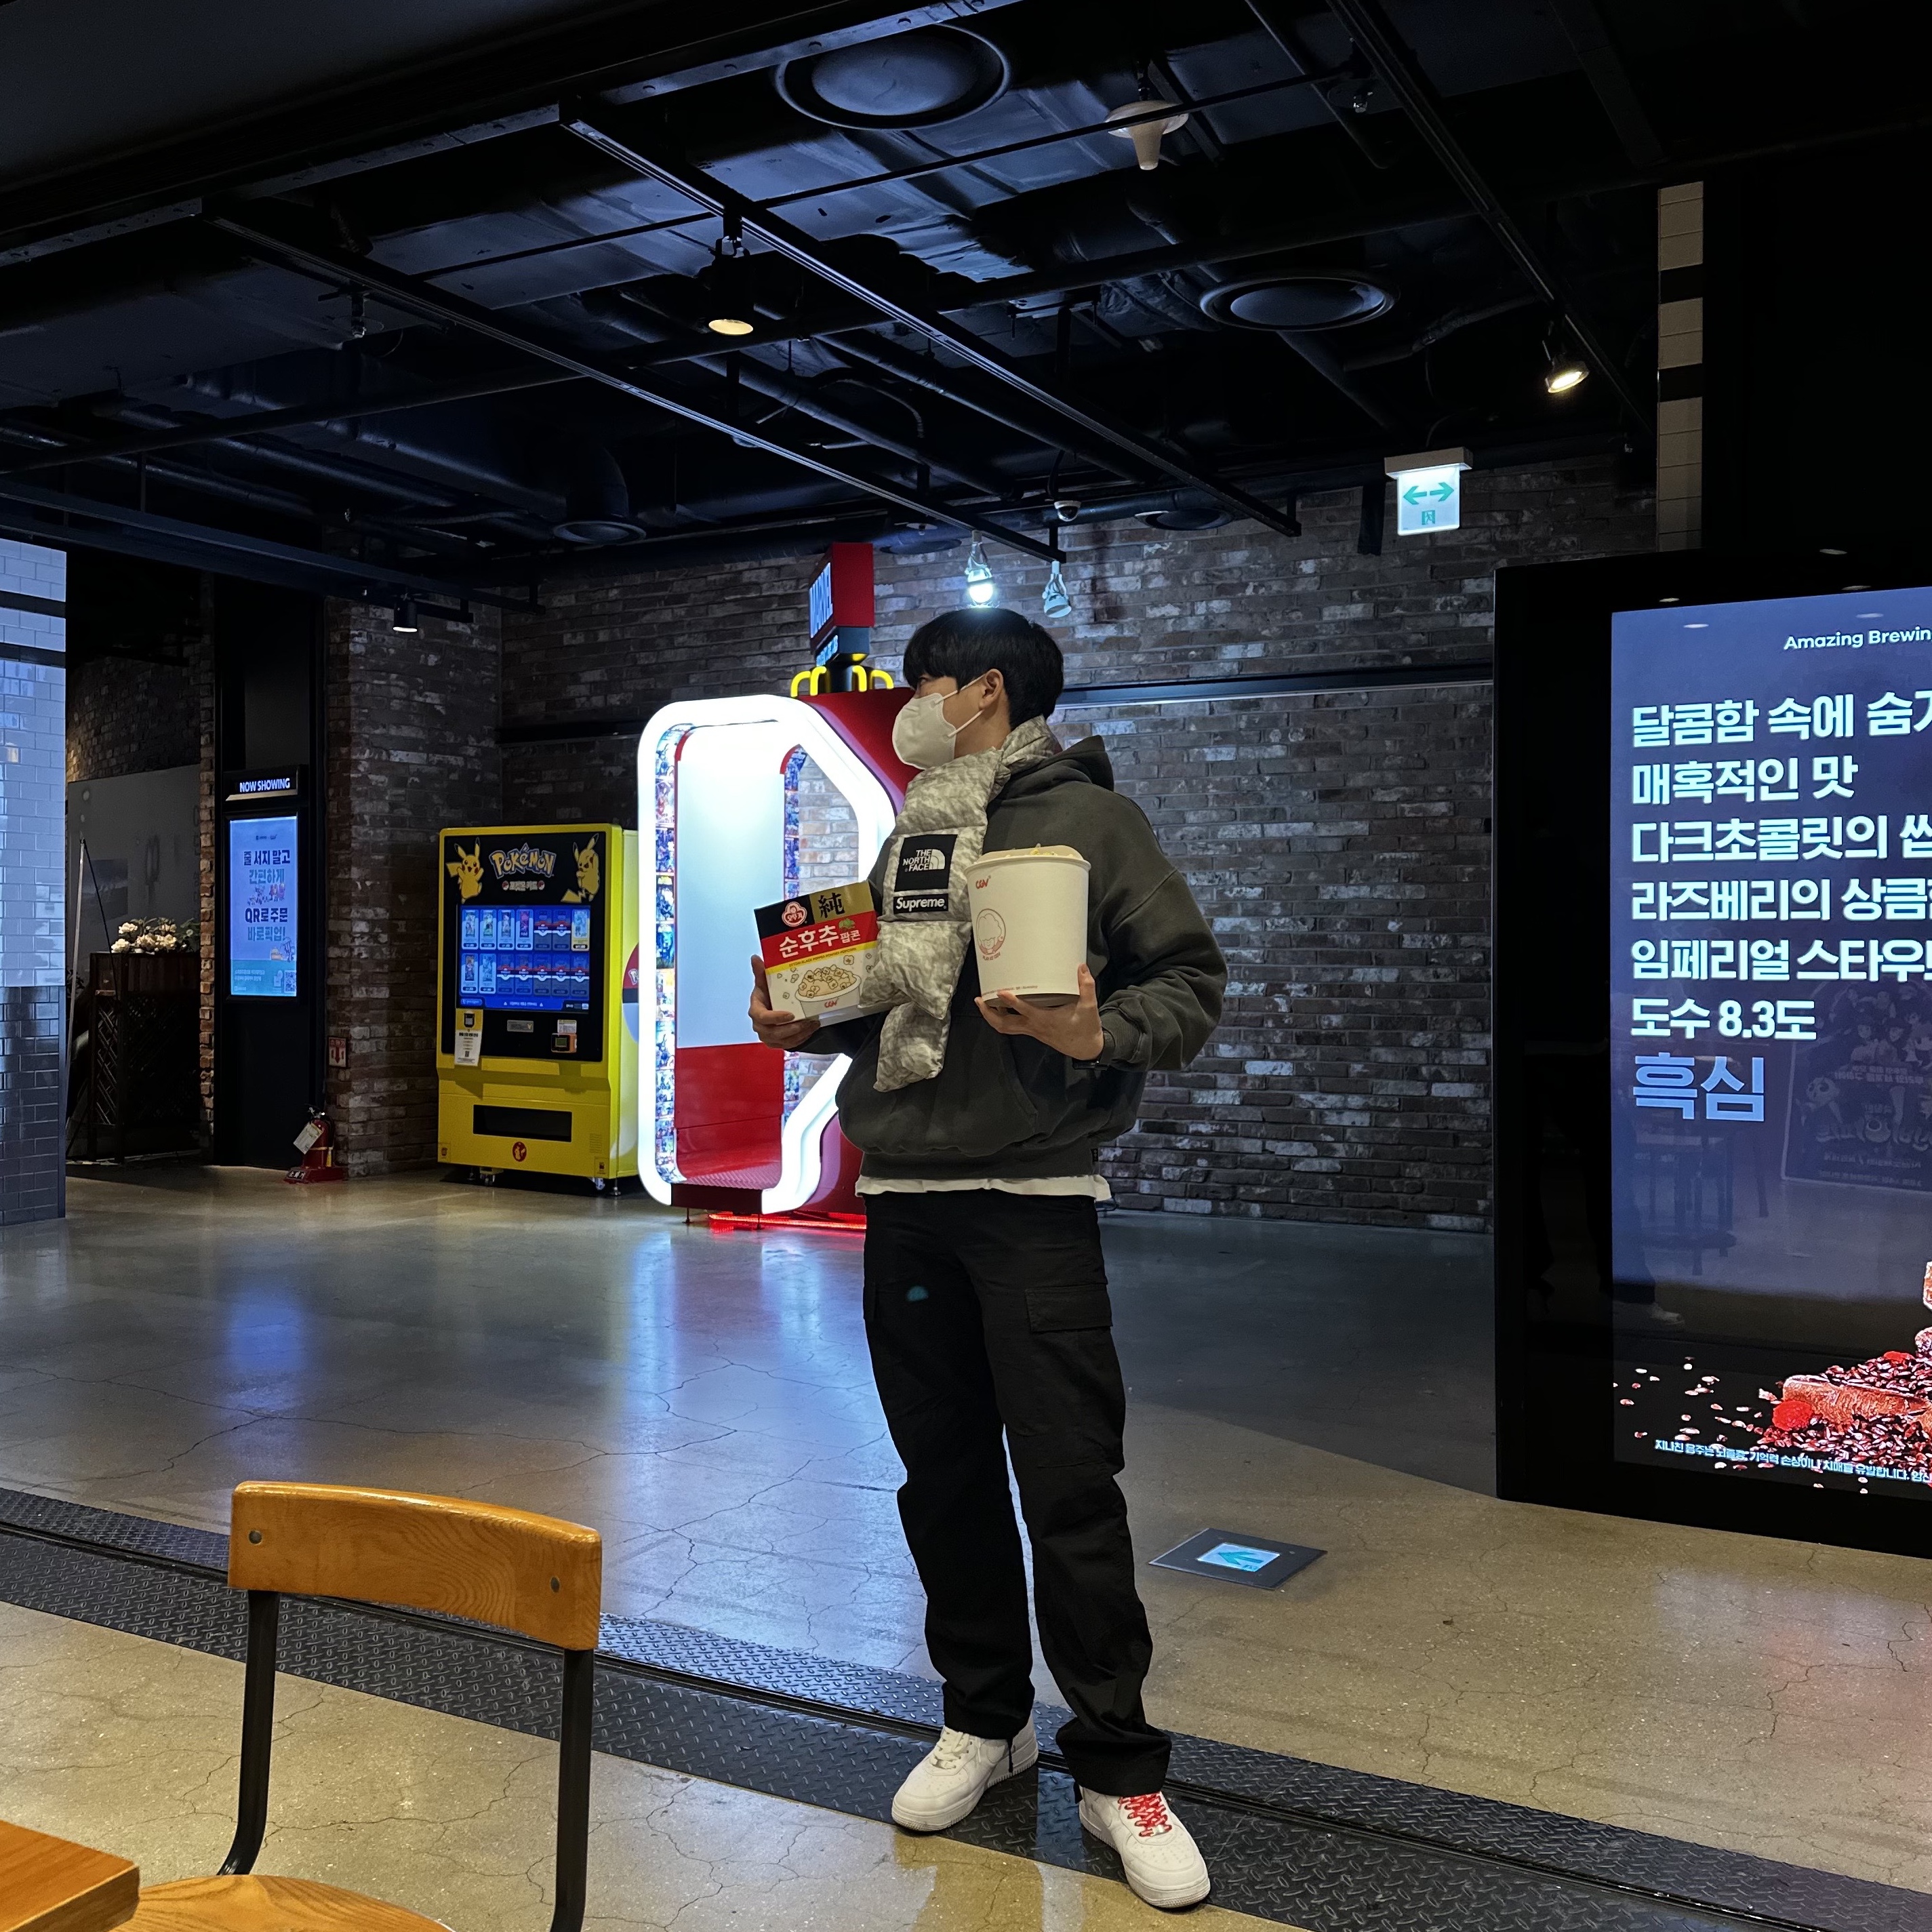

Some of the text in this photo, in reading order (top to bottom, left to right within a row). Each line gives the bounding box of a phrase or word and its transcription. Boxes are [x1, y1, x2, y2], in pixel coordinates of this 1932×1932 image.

[1784, 626, 1932, 649] Amazing Brewin
[1633, 700, 1760, 747] 달콤함
[1768, 693, 1855, 740] 속에
[239, 778, 290, 792] NOW SHOWING
[1632, 755, 1859, 805] 매혹적인 맛
[1632, 815, 1888, 863] 다크초콜릿의
[243, 849, 291, 866] 줄 서지 말고
[902, 856, 931, 866] NORTH
[916, 849, 932, 857] THE
[249, 868, 285, 885] 간편하게
[908, 863, 929, 872] FACE
[975, 878, 989, 889] CGV
[818, 892, 845, 919] 純
[895, 897, 945, 912] Supreme
[1631, 878, 1932, 921] 라즈베리의 상큼
[245, 907, 288, 923] QR로 주문
[779, 925, 861, 959] 순후추 팝콘
[1630, 939, 1932, 982] 임페리얼 스타우
[824, 999, 838, 1008] CGV
[1630, 998, 1817, 1041] 도수 8.3도
[1633, 1052, 1765, 1123] 흑심
[1655, 1439, 1685, 1453] 지나친
[1685, 1443, 1715, 1457] 음주는
[1749, 1451, 1779, 1464] 기억력
[1781, 1454, 1822, 1470] 손상이나
[1822, 1461, 1853, 1474] 치매를
[1855, 1464, 1910, 1480] 유발합니다.
